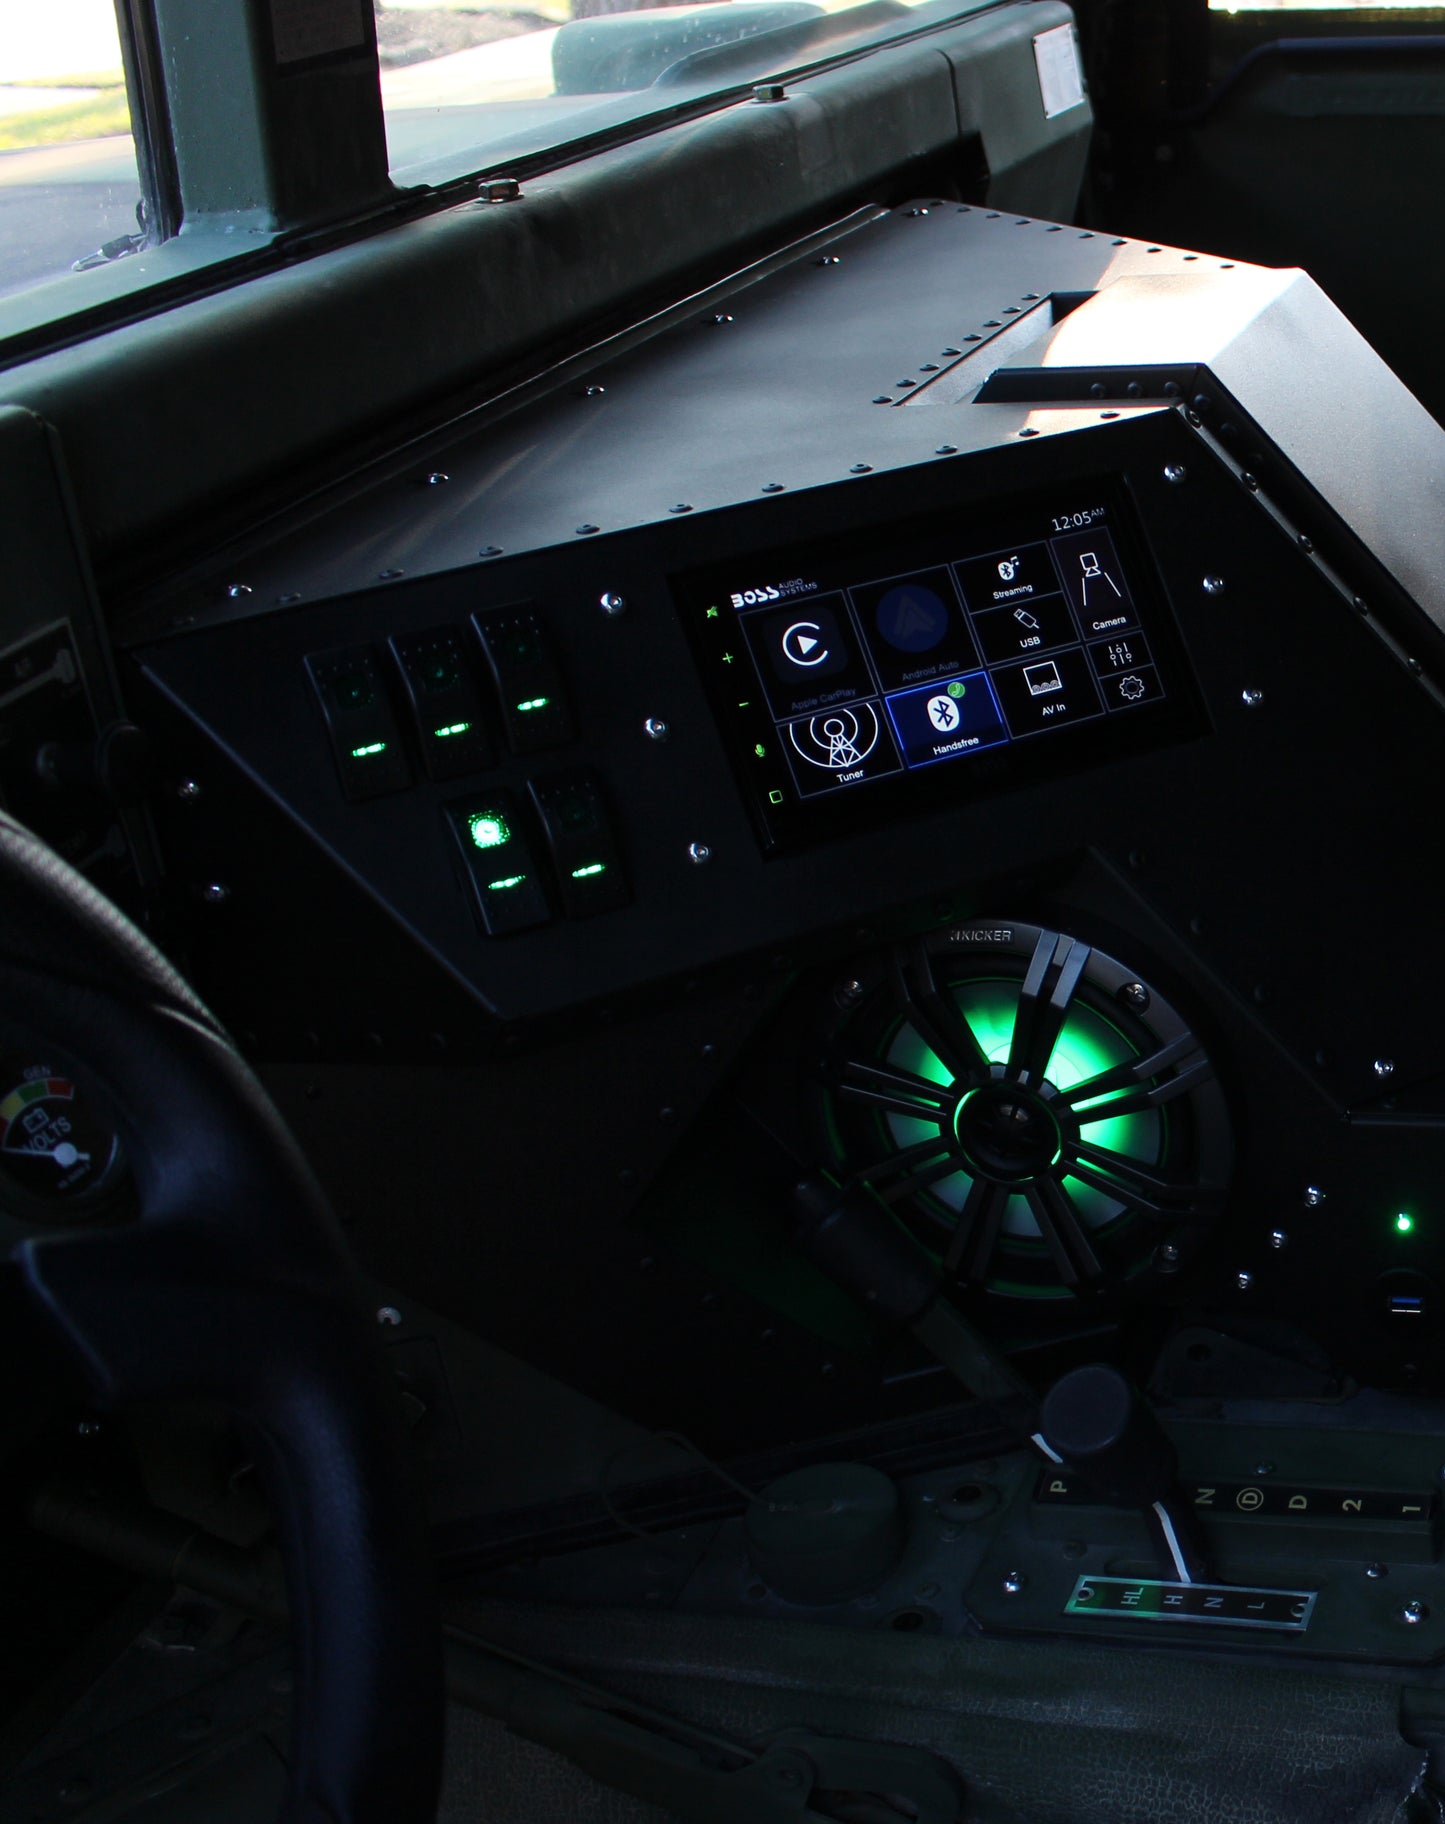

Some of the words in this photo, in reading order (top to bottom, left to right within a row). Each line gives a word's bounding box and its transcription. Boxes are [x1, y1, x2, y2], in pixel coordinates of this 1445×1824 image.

[1051, 511, 1092, 532] 12:05
[1091, 507, 1105, 518] AM
[779, 578, 803, 589] AUDIO
[780, 582, 818, 597] SYSTEMS
[730, 586, 780, 608] BOSS
[993, 584, 1033, 600] Streaming
[1092, 616, 1127, 631] Camera
[1019, 636, 1041, 649] USB
[901, 667, 936, 681] Android
[938, 661, 960, 673] Auto
[790, 696, 818, 711] Apple
[819, 688, 857, 703] CarPlay
[1042, 705, 1055, 717] AV
[1056, 703, 1066, 713] In
[932, 737, 980, 755] Handsfree
[836, 770, 864, 783] Tuner
[961, 930, 1012, 941] KICKER
[1050, 1480, 1067, 1493] P
[1194, 1488, 1216, 1504] N
[1288, 1495, 1308, 1510] D
[1342, 1498, 1362, 1512] 2
[1402, 1505, 1422, 1513] 1
[1120, 1587, 1144, 1605] HL
[1163, 1594, 1184, 1605] H
[1203, 1596, 1224, 1608] N
[1247, 1601, 1265, 1610] L
